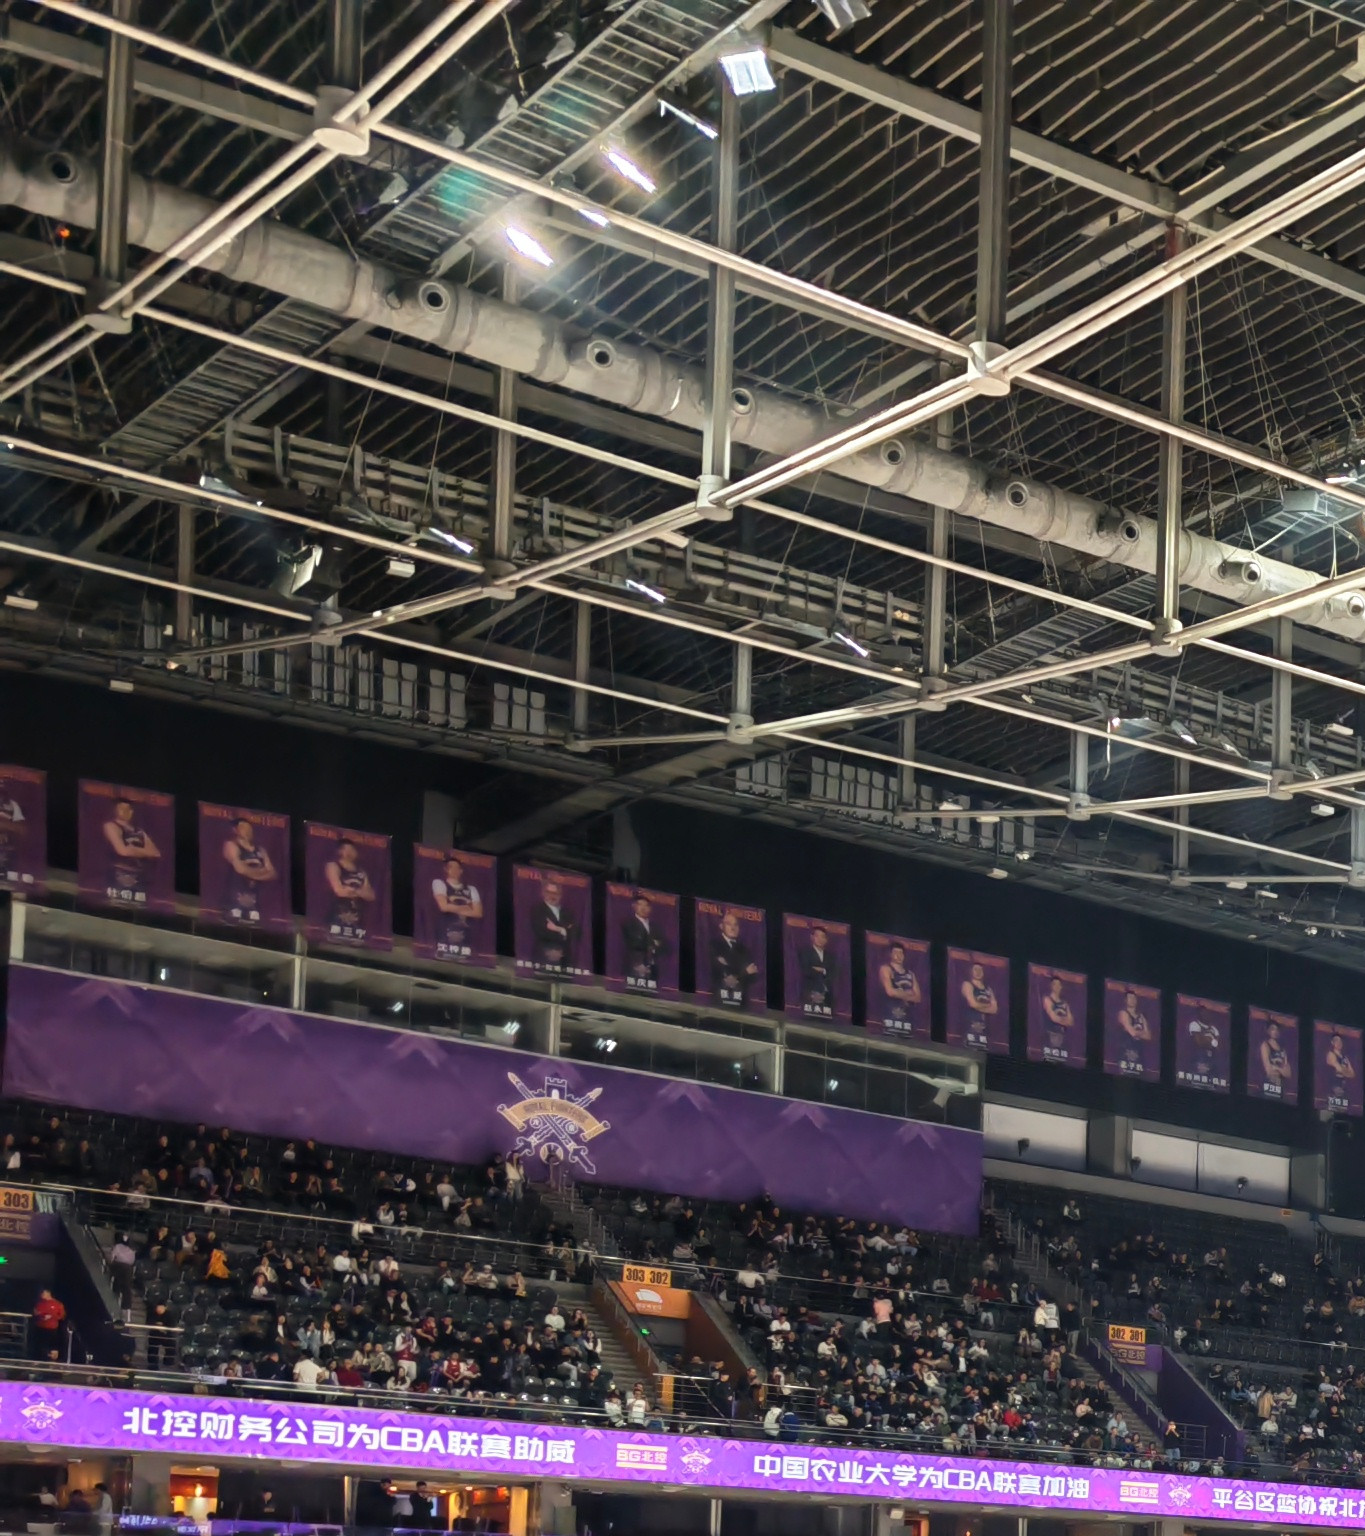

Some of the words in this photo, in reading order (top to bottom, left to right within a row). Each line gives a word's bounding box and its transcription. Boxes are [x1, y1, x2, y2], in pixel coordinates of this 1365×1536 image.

[624, 1266, 643, 1283] 303
[649, 1268, 669, 1285] 302
[1111, 1326, 1126, 1341] 302
[1130, 1328, 1144, 1342] 301
[124, 1407, 575, 1463] 北控财务公司为CBA联赛助威
[754, 1455, 1089, 1499] 中国农业大学为CBA联赛加油
